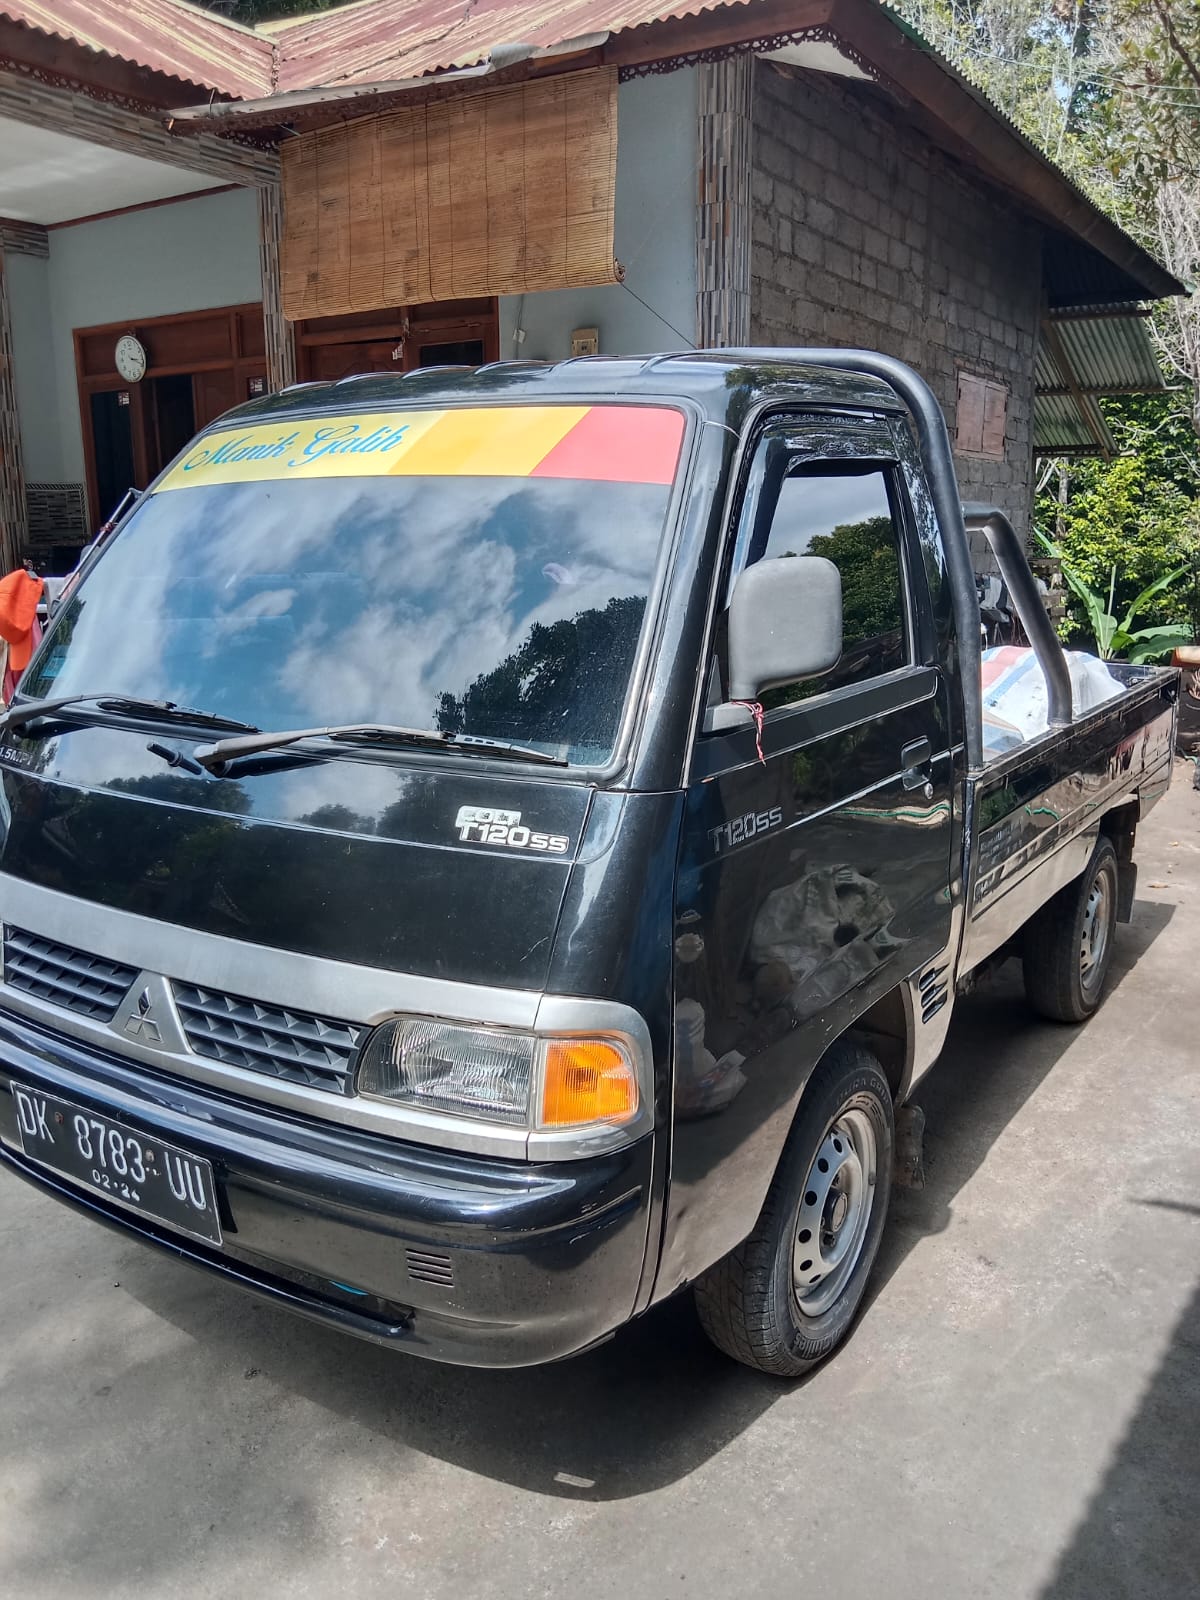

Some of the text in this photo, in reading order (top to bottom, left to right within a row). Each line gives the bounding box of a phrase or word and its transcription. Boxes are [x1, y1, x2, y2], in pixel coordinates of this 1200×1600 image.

[184, 425, 410, 471] Manik Galih
[459, 822, 569, 853] T120SS
[17, 1091, 207, 1211] DK 8783 UU
